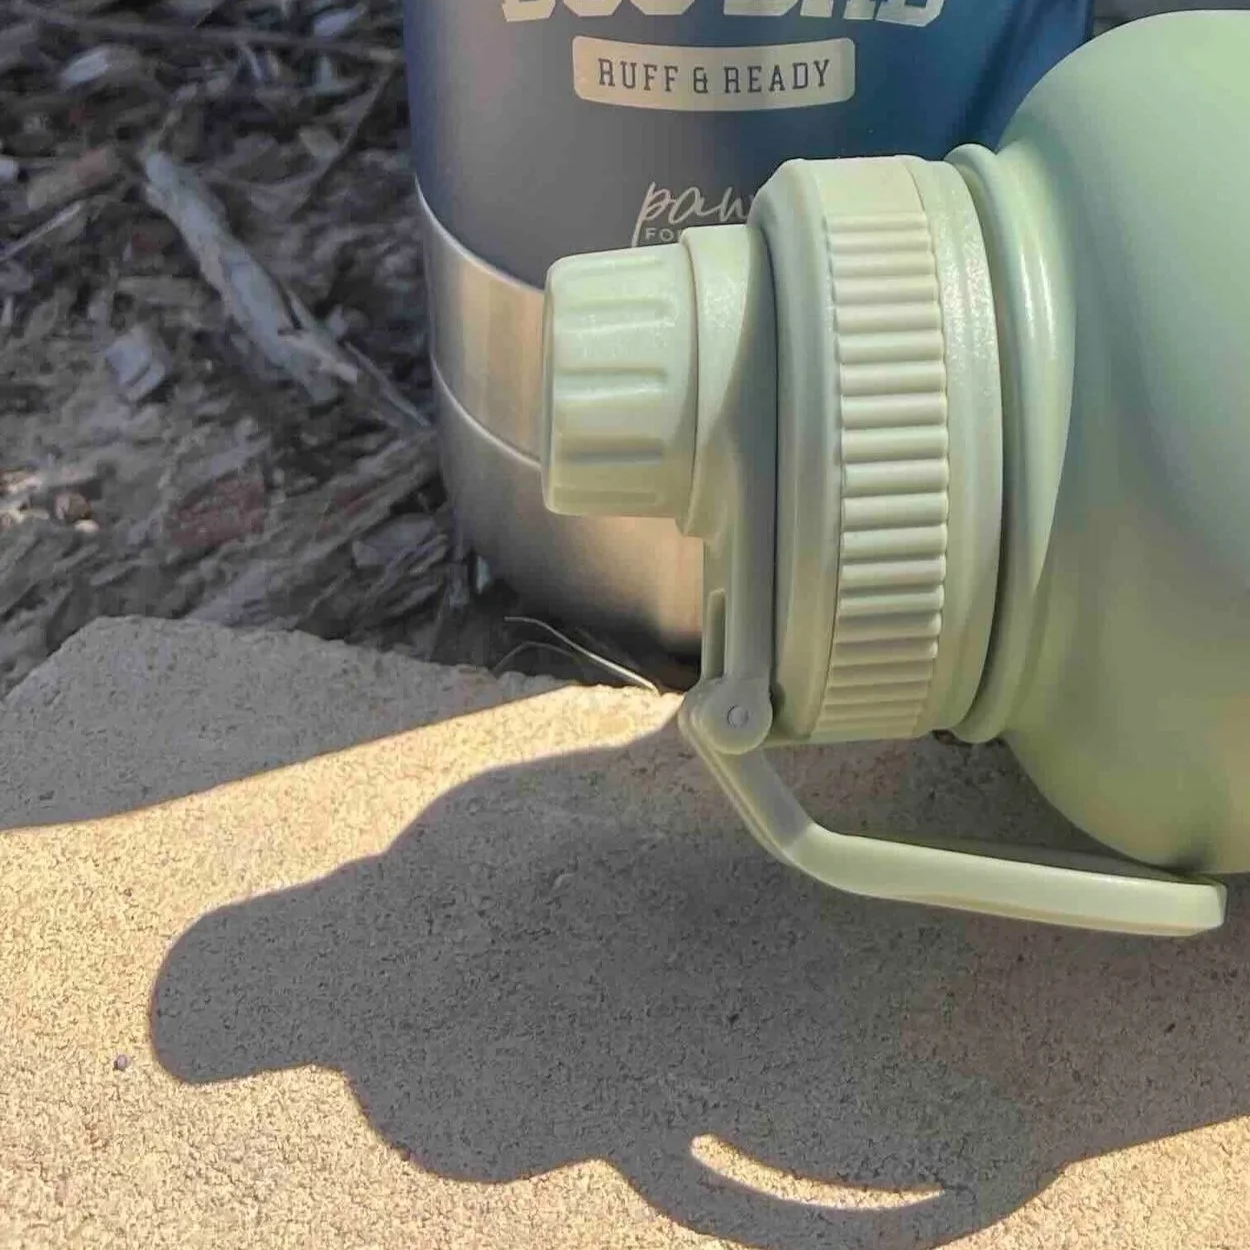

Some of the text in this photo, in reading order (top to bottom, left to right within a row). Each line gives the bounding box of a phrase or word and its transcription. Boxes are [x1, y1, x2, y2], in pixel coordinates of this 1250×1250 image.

[597, 58, 830, 94] RUFF & READY
[631, 181, 755, 249] paw
[644, 226, 681, 243] FO
